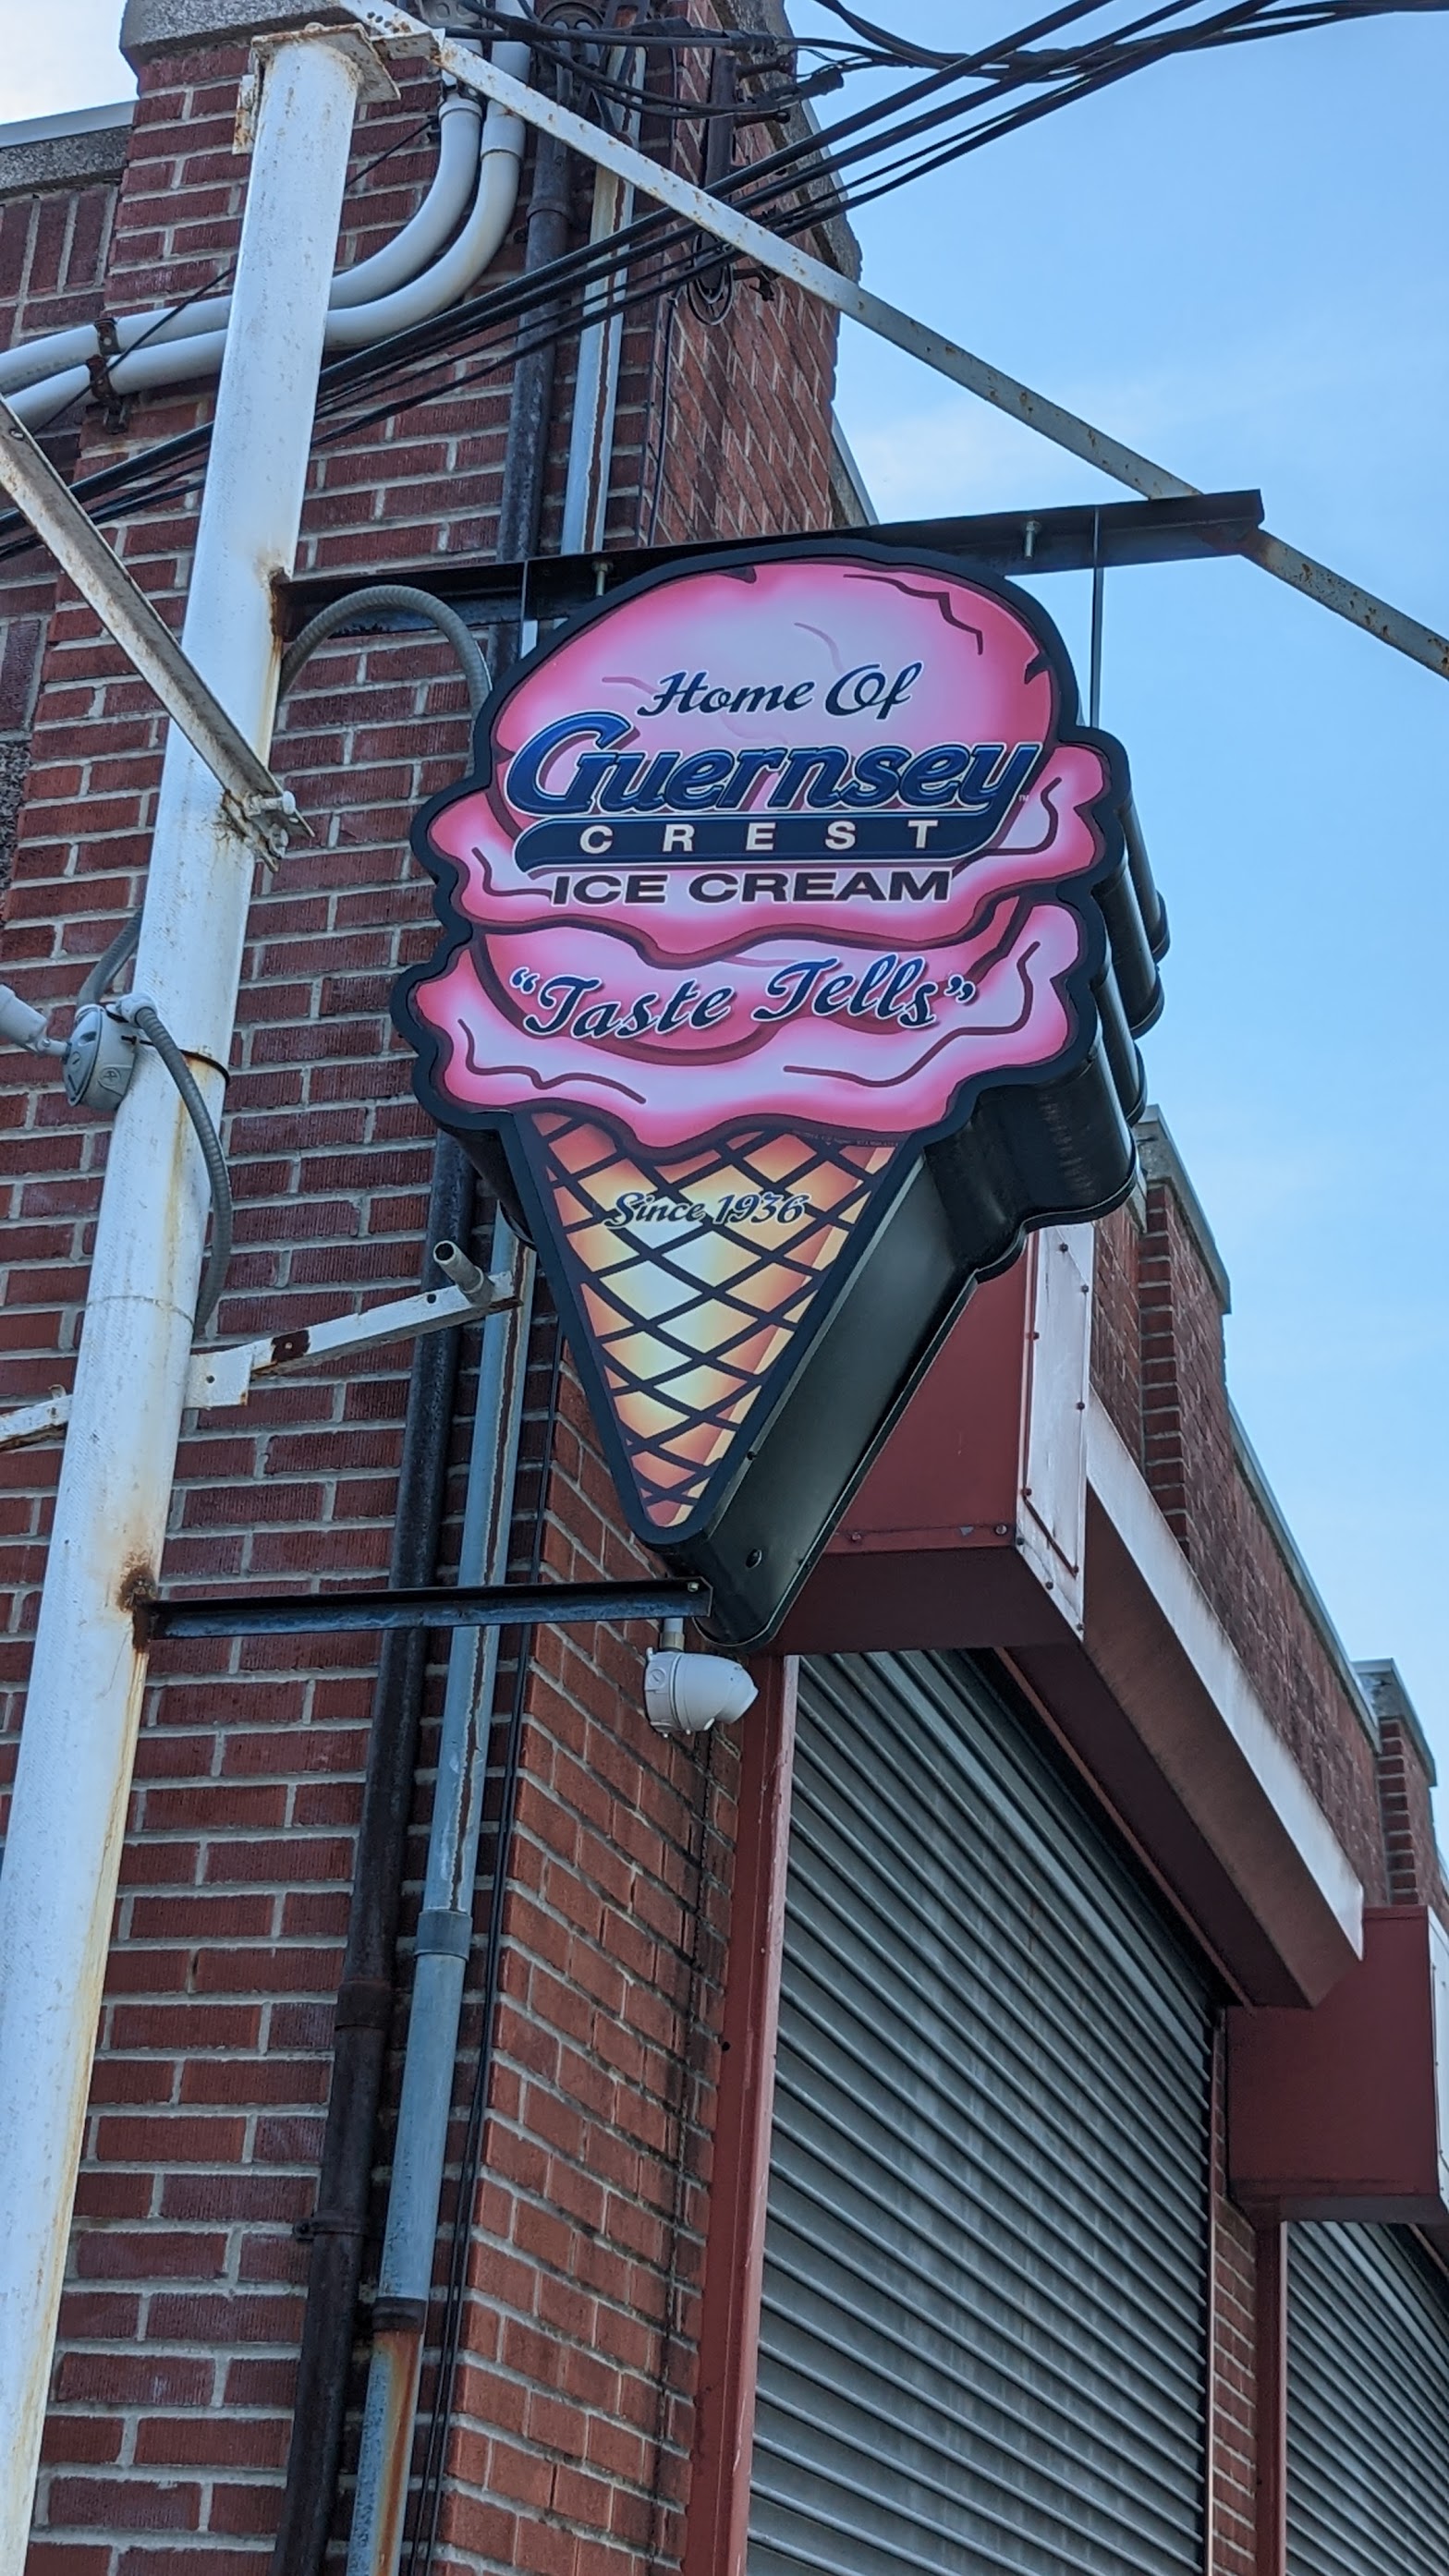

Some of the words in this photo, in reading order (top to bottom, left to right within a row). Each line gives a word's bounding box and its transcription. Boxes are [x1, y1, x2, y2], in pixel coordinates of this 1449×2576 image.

[638, 671, 816, 716] Home
[825, 662, 922, 719] Of
[506, 713, 1041, 815] Guernsey
[578, 820, 939, 855] CREST
[554, 873, 666, 905] ICE
[688, 872, 952, 904] CREAM
[603, 1192, 707, 1227] Since
[715, 1192, 810, 1225] 1936
